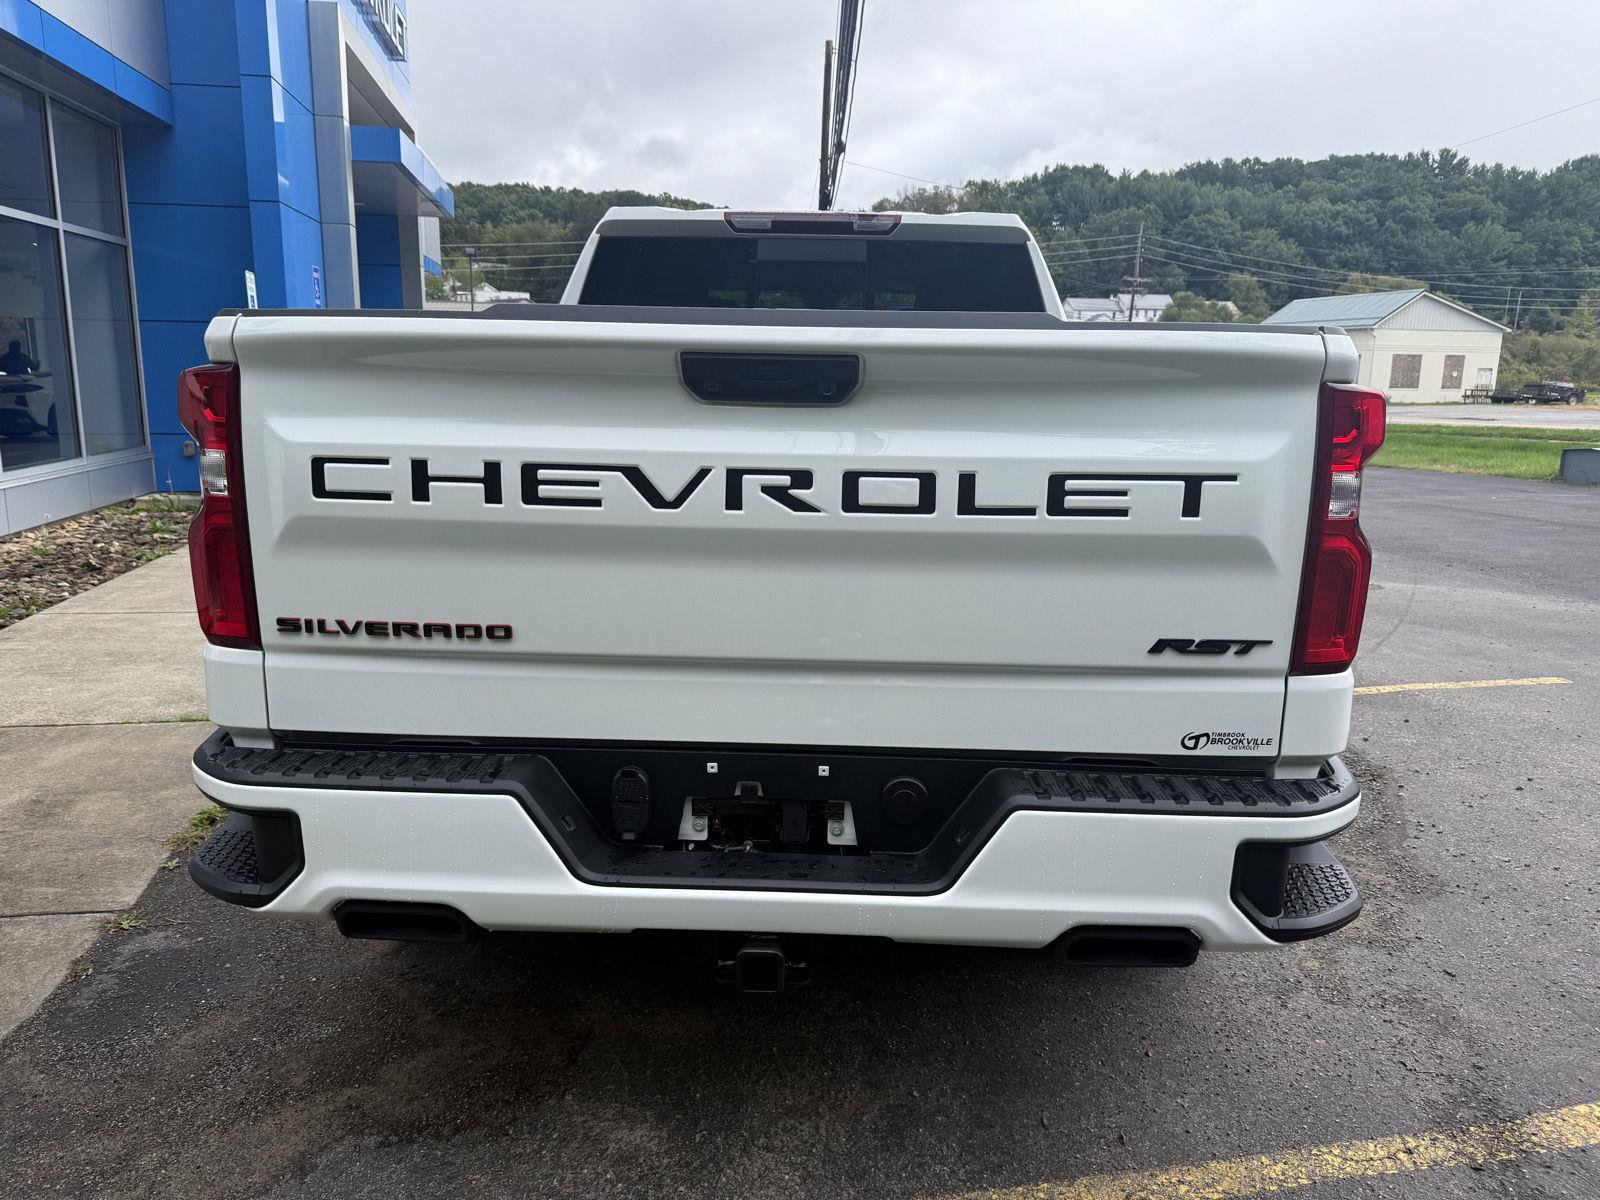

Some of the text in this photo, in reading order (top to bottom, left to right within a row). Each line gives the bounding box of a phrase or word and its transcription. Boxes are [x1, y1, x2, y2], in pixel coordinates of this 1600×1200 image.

[310, 456, 1239, 519] CHEVROLET
[276, 616, 513, 640] SILVERADO
[1147, 638, 1274, 656] RST
